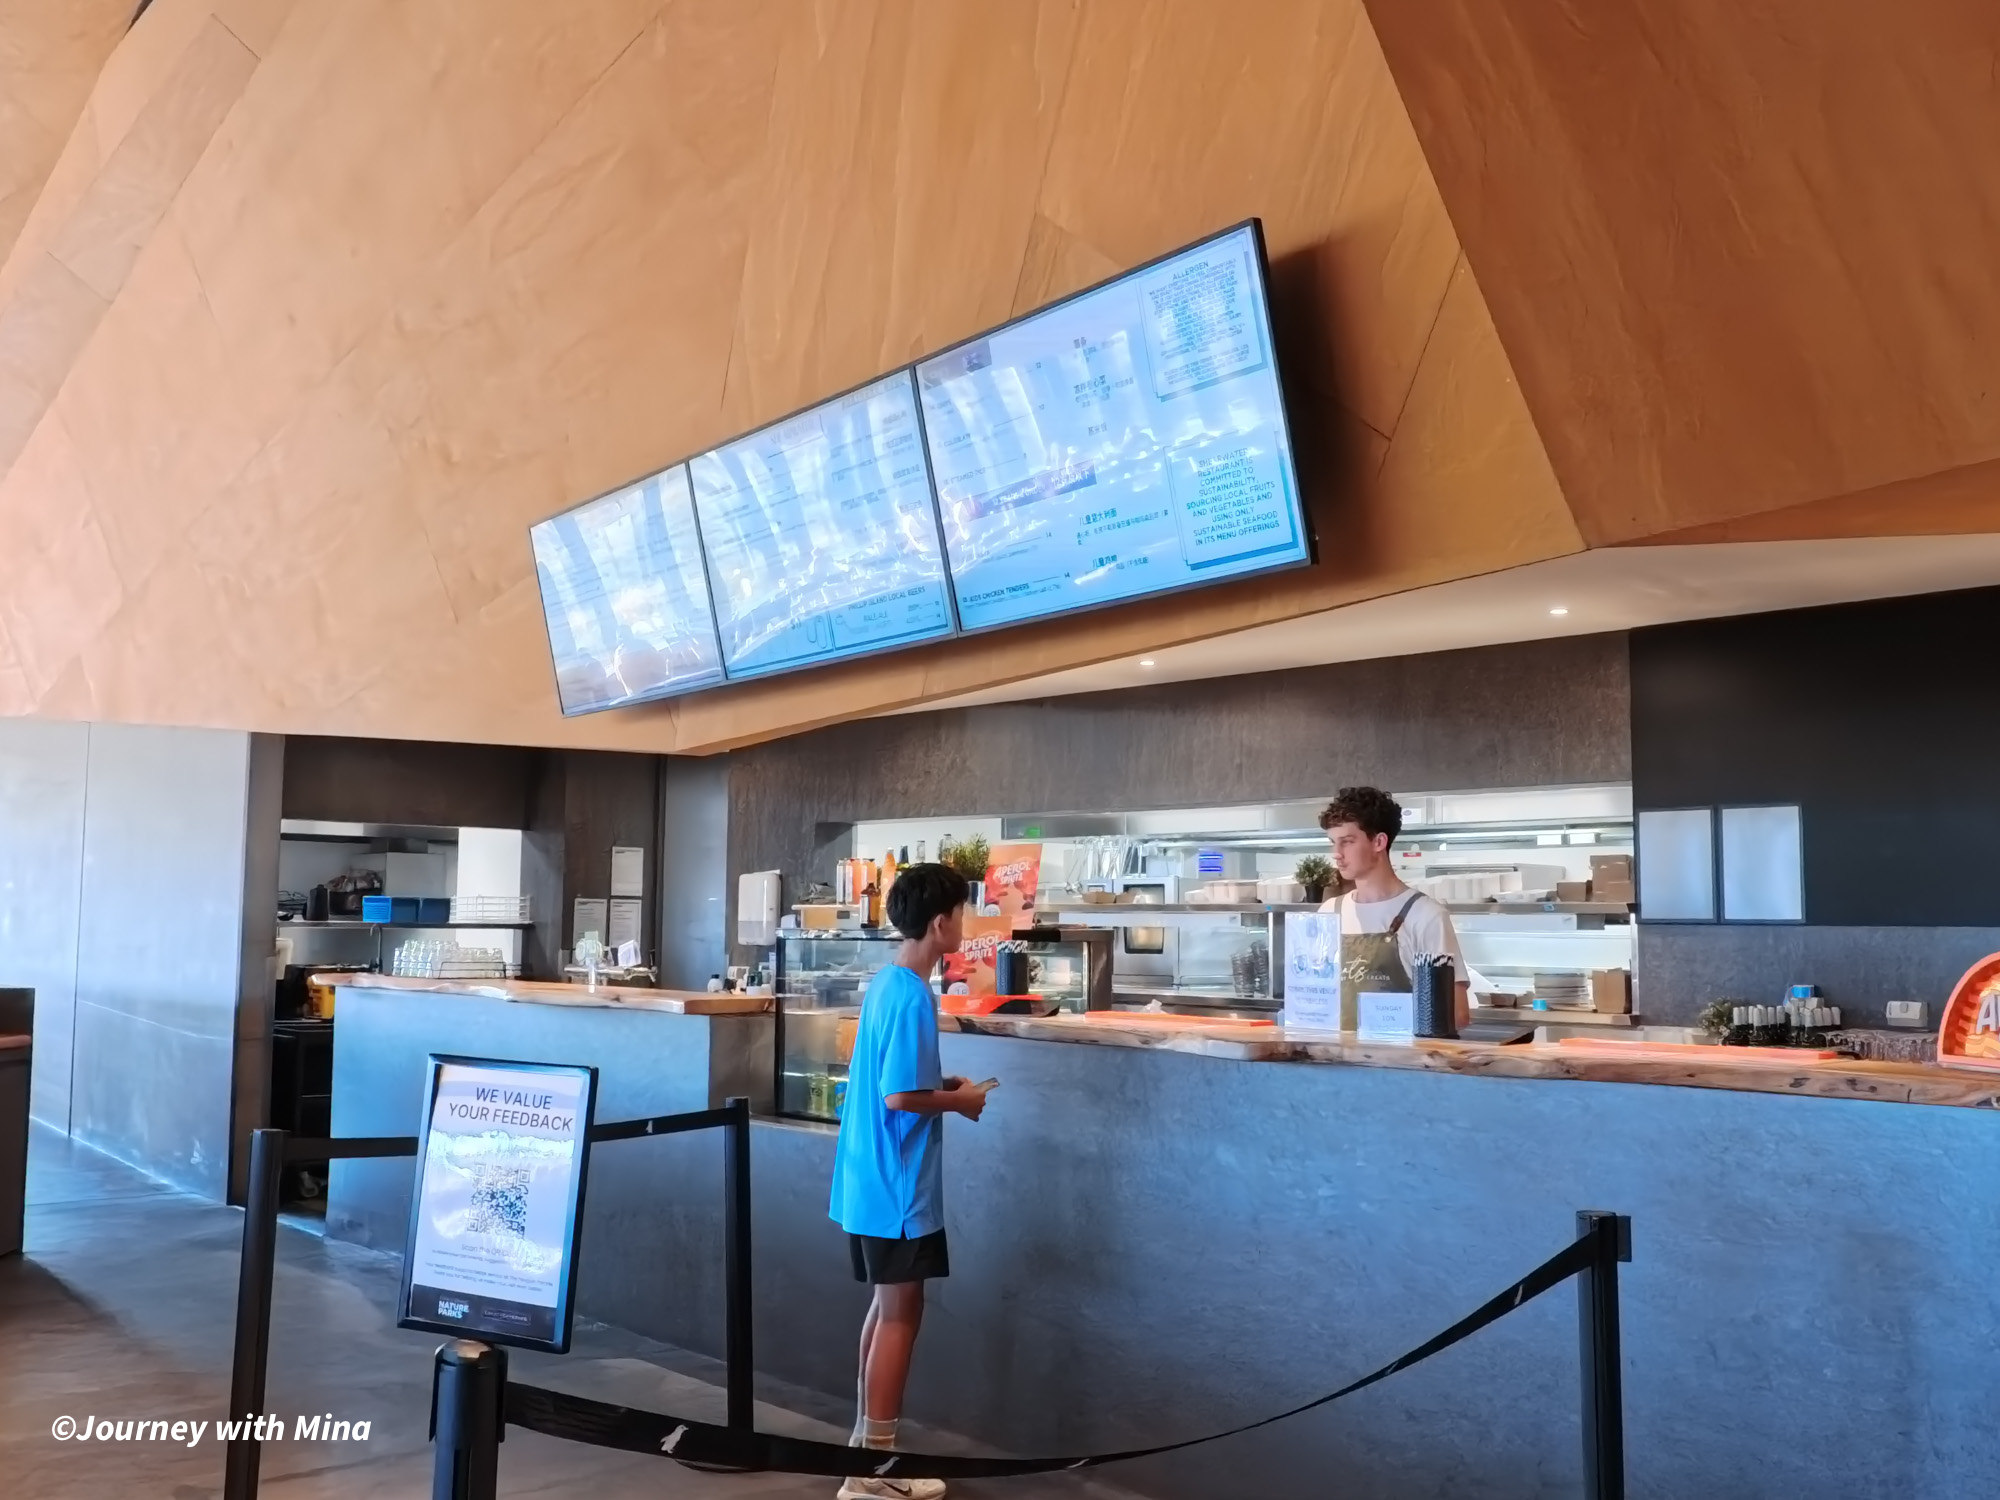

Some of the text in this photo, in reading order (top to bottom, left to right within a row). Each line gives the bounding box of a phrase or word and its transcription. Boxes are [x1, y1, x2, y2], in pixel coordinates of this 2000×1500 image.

[1172, 260, 1209, 280] ALLERGEN
[1198, 458, 1244, 477] RESTAURANT
[1200, 466, 1254, 486] COMMITTED TO
[1186, 480, 1276, 510] SOURCING LOCAL FRUITS
[1199, 476, 1258, 497] SUSTAINABILITY,
[1192, 491, 1273, 518] AND VEGETABLES AND
[1212, 506, 1254, 522] USING ONLY
[1194, 510, 1278, 536] SUSTAINABLE SEAFOOD
[1196, 520, 1280, 546] IN ITS MENU OFFERINGS
[868, 595, 887, 606] ISLAND
[888, 592, 906, 601] LOCAL
[908, 586, 926, 596] BEERS
[970, 594, 982, 602] KIDS
[982, 589, 1004, 600] CHICKEN
[1006, 582, 1030, 594] TENDERS
[993, 860, 1030, 879] APEROL
[1000, 870, 1023, 885] SPRITZ
[964, 948, 993, 961] SPRITZ
[476, 1087, 552, 1110] WE VALUE
[449, 1102, 573, 1132] YOUR FEEDBACK
[462, 1244, 478, 1252] Scan
[438, 1300, 469, 1313] NATURE
[438, 1308, 463, 1319] PARKS
